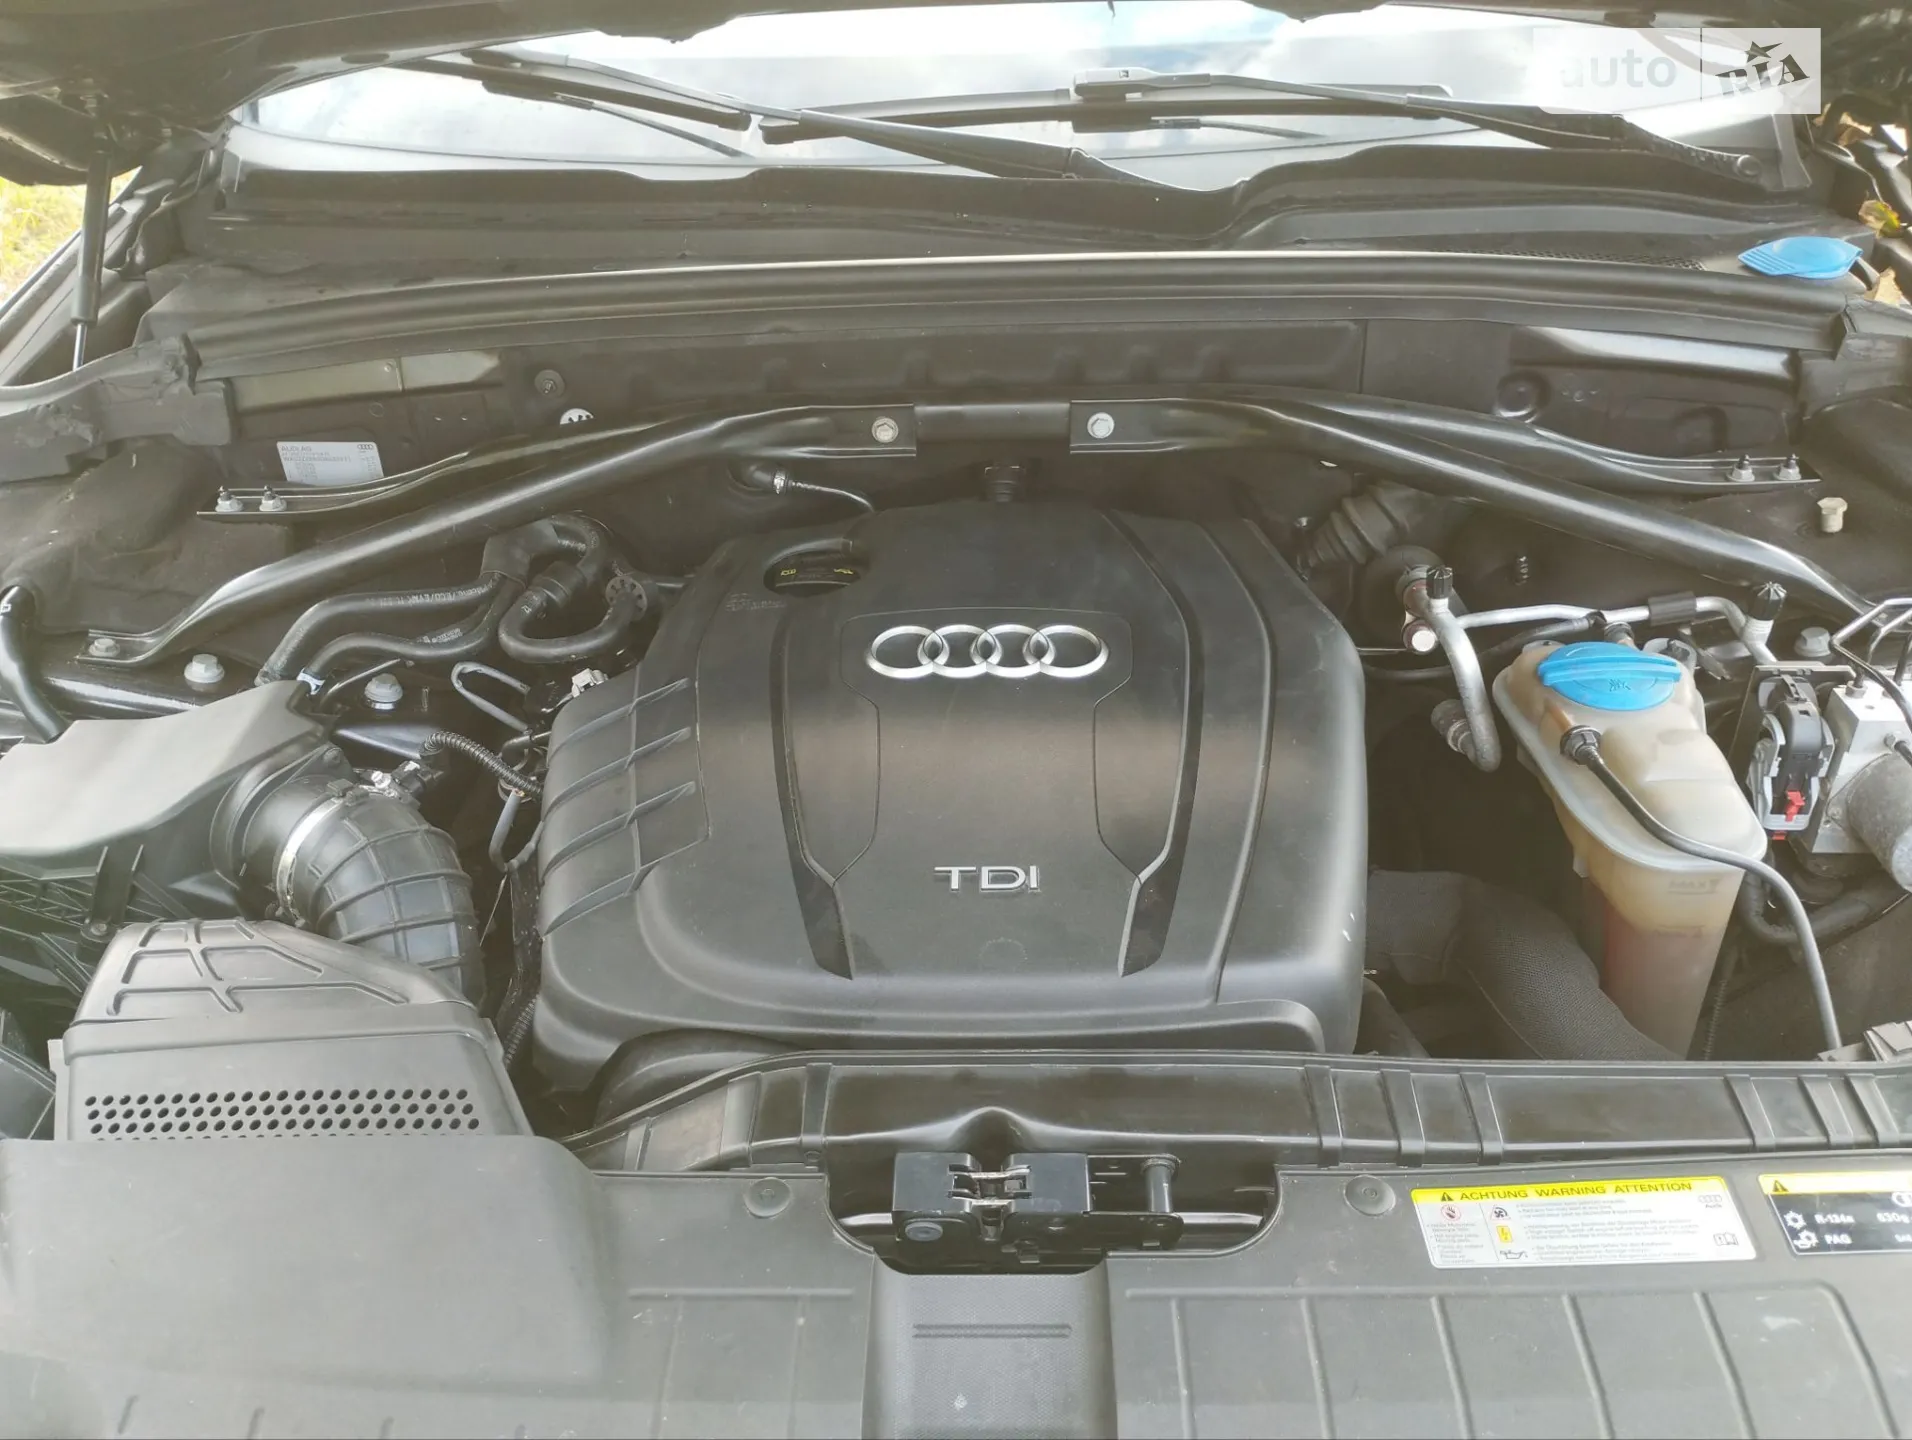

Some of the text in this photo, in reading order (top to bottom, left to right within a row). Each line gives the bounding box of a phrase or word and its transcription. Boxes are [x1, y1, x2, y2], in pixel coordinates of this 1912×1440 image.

[934, 865, 1040, 891] TDI
[1460, 1182, 1692, 1200] ACHTUNG WARNING ATTENTION
[1824, 1233, 1853, 1245] PAG
